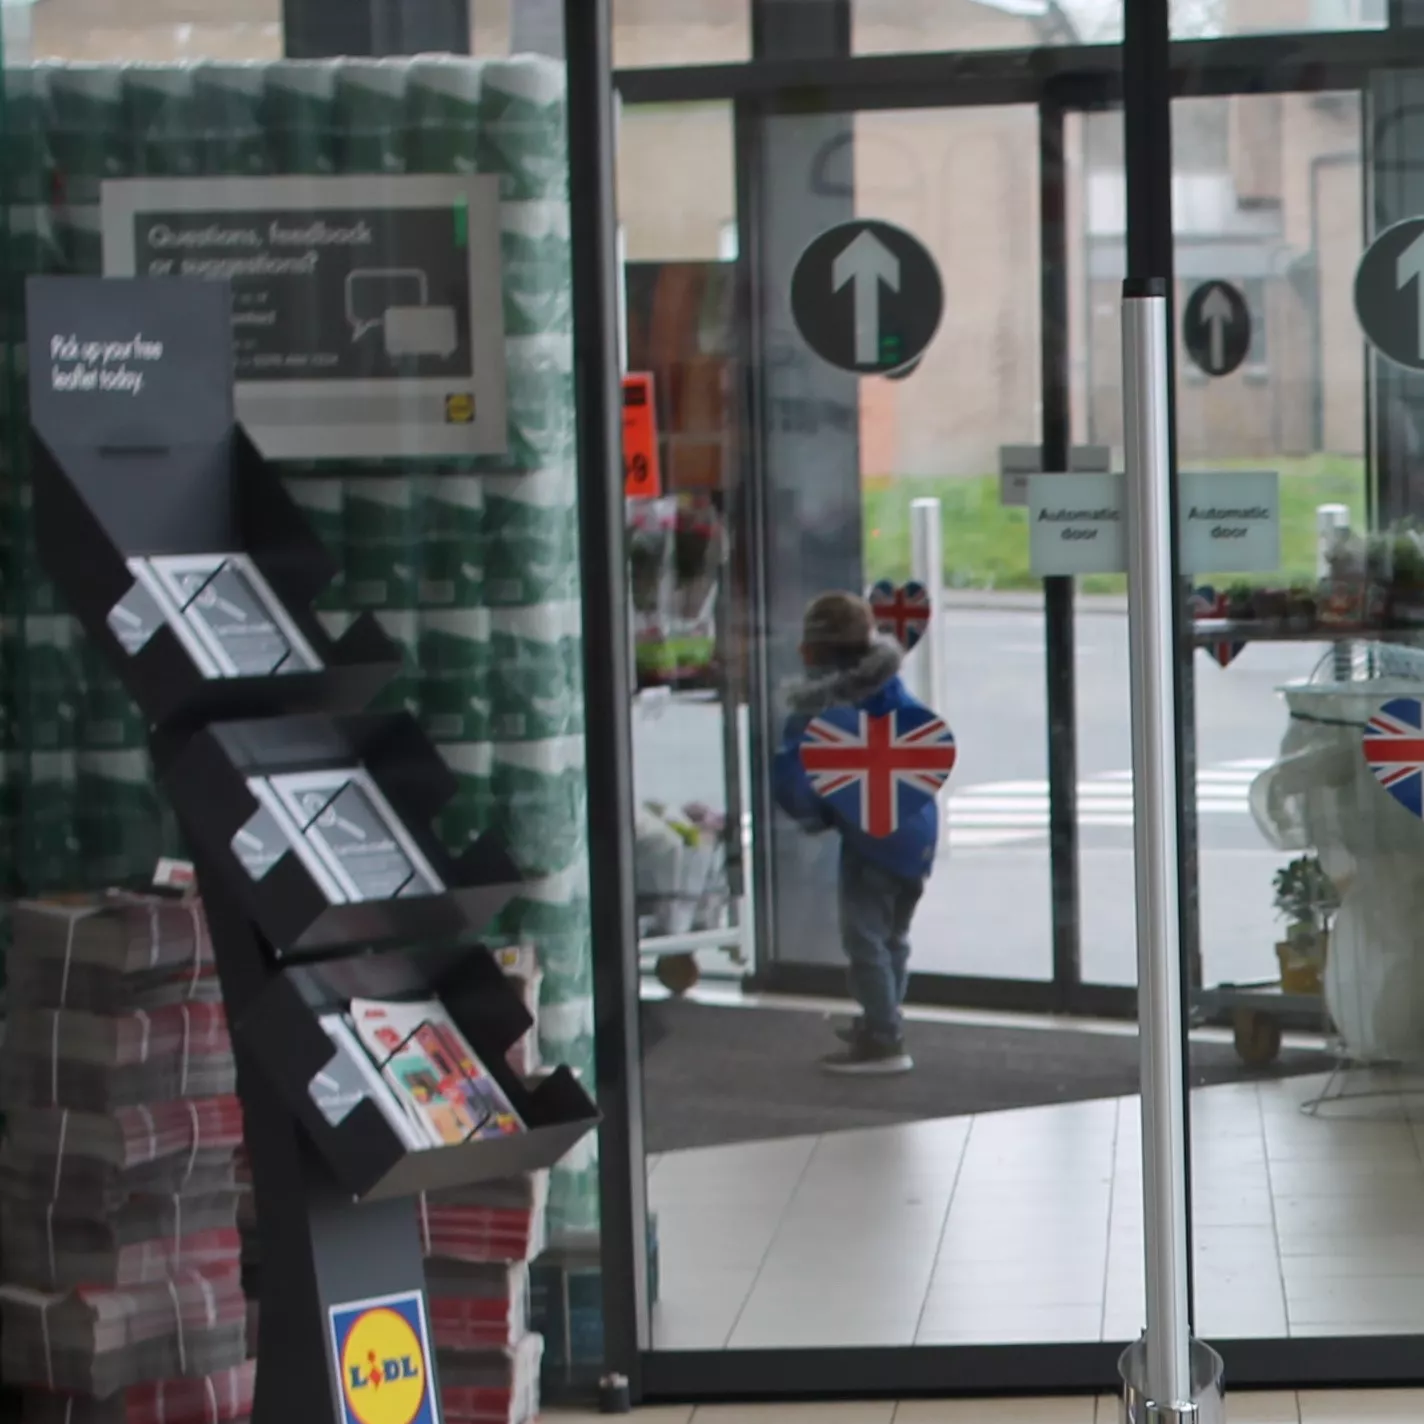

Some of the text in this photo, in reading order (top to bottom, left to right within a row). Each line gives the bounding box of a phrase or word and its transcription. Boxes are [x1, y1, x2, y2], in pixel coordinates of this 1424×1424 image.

[50, 332, 79, 361] Pick
[102, 340, 133, 366] your
[1038, 507, 1120, 522] Automatic
[1188, 506, 1270, 521] Automatic
[1061, 528, 1098, 541] door
[1209, 526, 1248, 539] door
